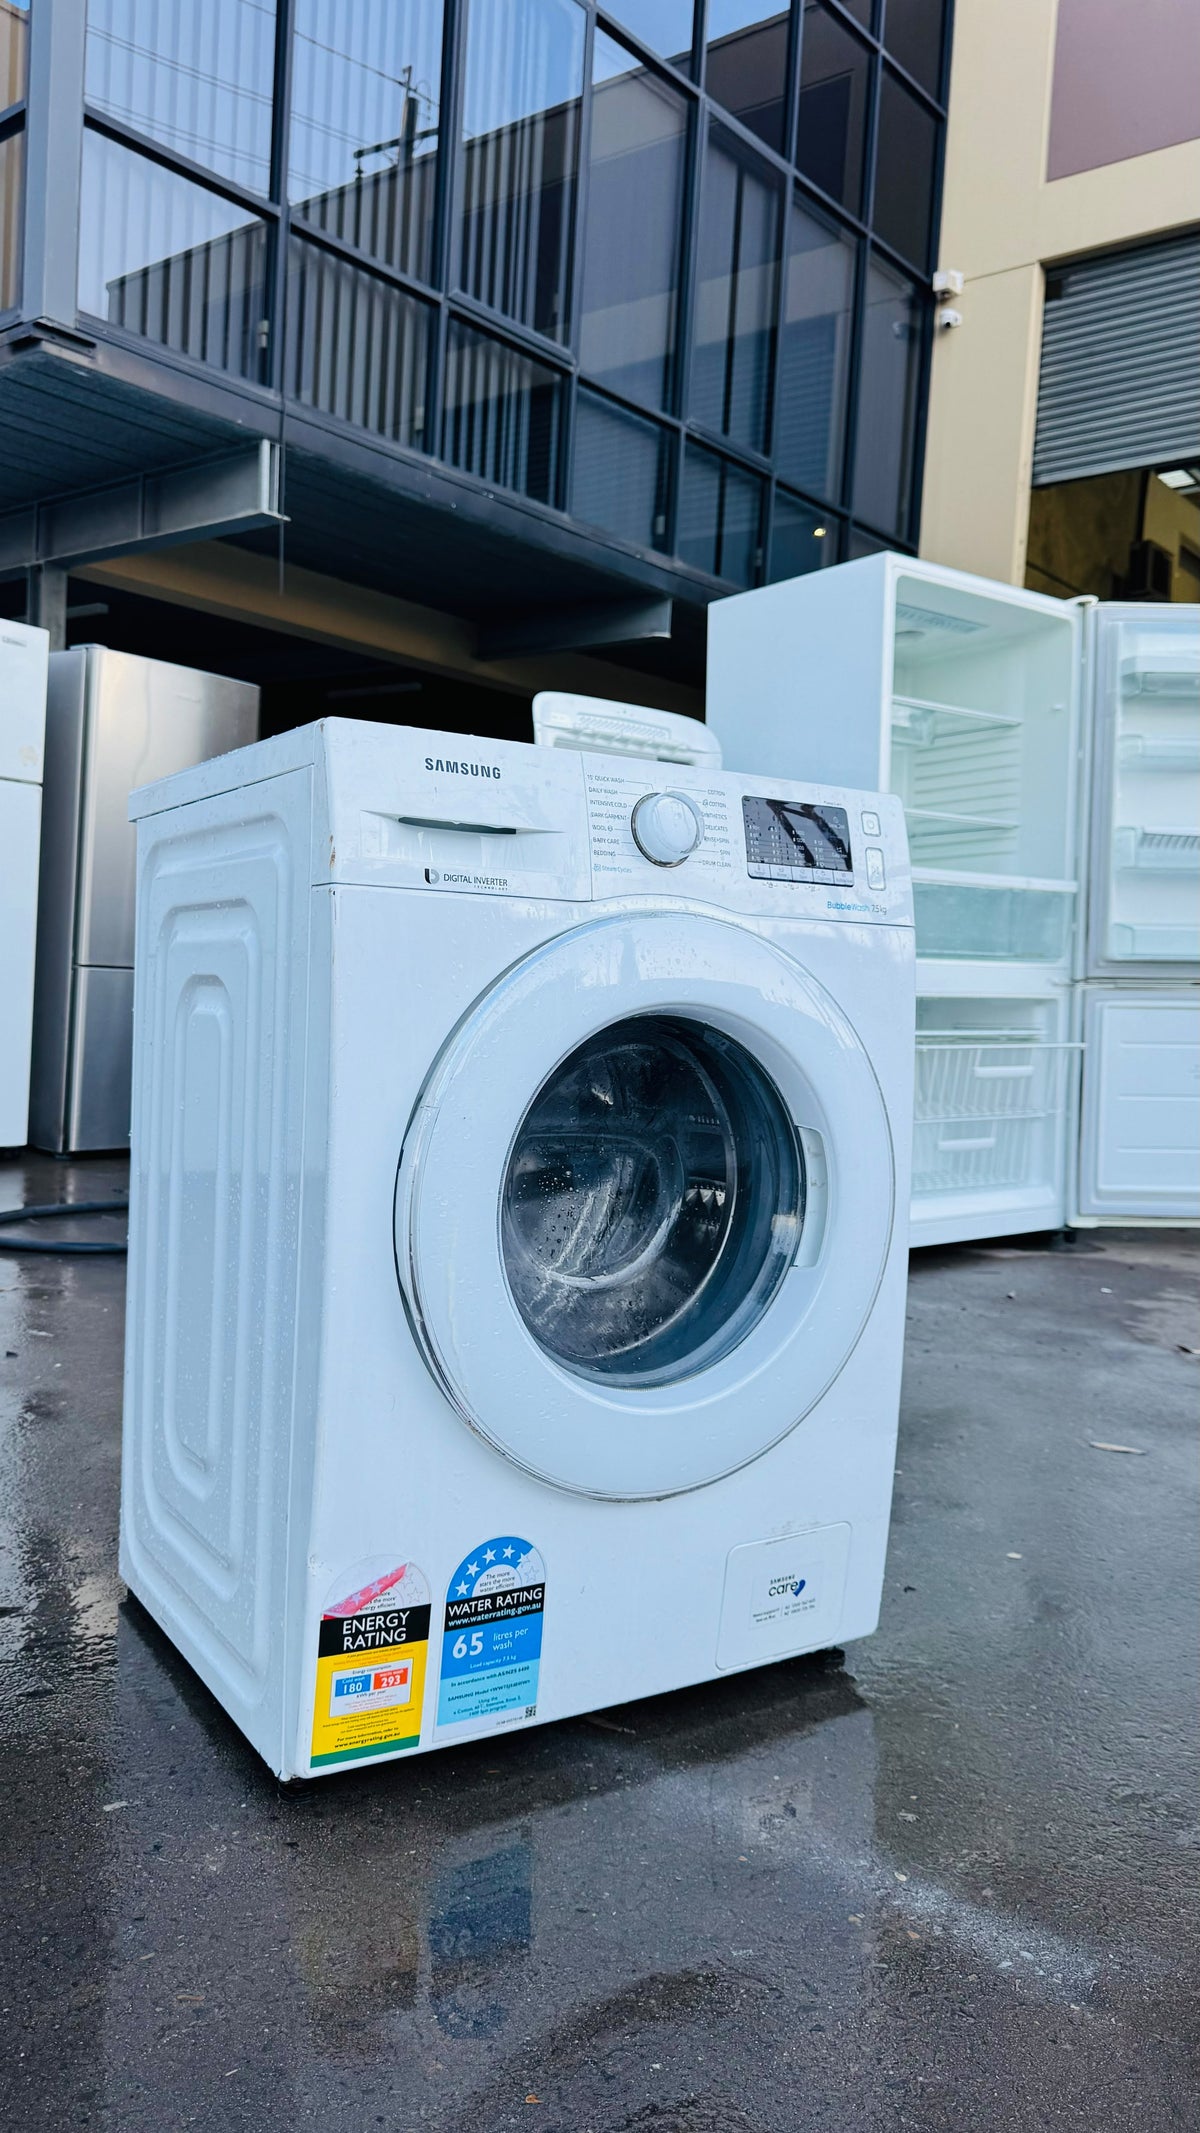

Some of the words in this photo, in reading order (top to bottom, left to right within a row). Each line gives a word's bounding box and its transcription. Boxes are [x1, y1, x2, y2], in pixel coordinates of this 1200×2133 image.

[425, 758, 501, 779] SAMSUNG
[707, 789, 725, 797] COTTON
[590, 799, 614, 808] INTENSIVE
[614, 801, 628, 809] COLD
[592, 824, 607, 832] WOOL
[592, 836, 607, 844] BABY
[593, 849, 616, 857] BEDDING
[702, 859, 716, 867] DRUM
[716, 860, 731, 868] CLEAN
[443, 873, 472, 884] DIGITAL
[473, 876, 508, 887] INVERTER
[768, 1581, 799, 1597] care
[448, 1599, 492, 1617] WATER
[496, 1588, 543, 1608] RATING
[448, 1602, 542, 1627] www.waterrating.gov.au
[342, 1611, 410, 1635] ENERGY
[343, 1628, 407, 1651] RATING
[452, 1631, 484, 1659] 65
[493, 1632, 513, 1642] litres
[514, 1628, 529, 1638] per
[492, 1640, 513, 1651] wash
[343, 1682, 363, 1695] 180
[381, 1675, 401, 1688] 293
